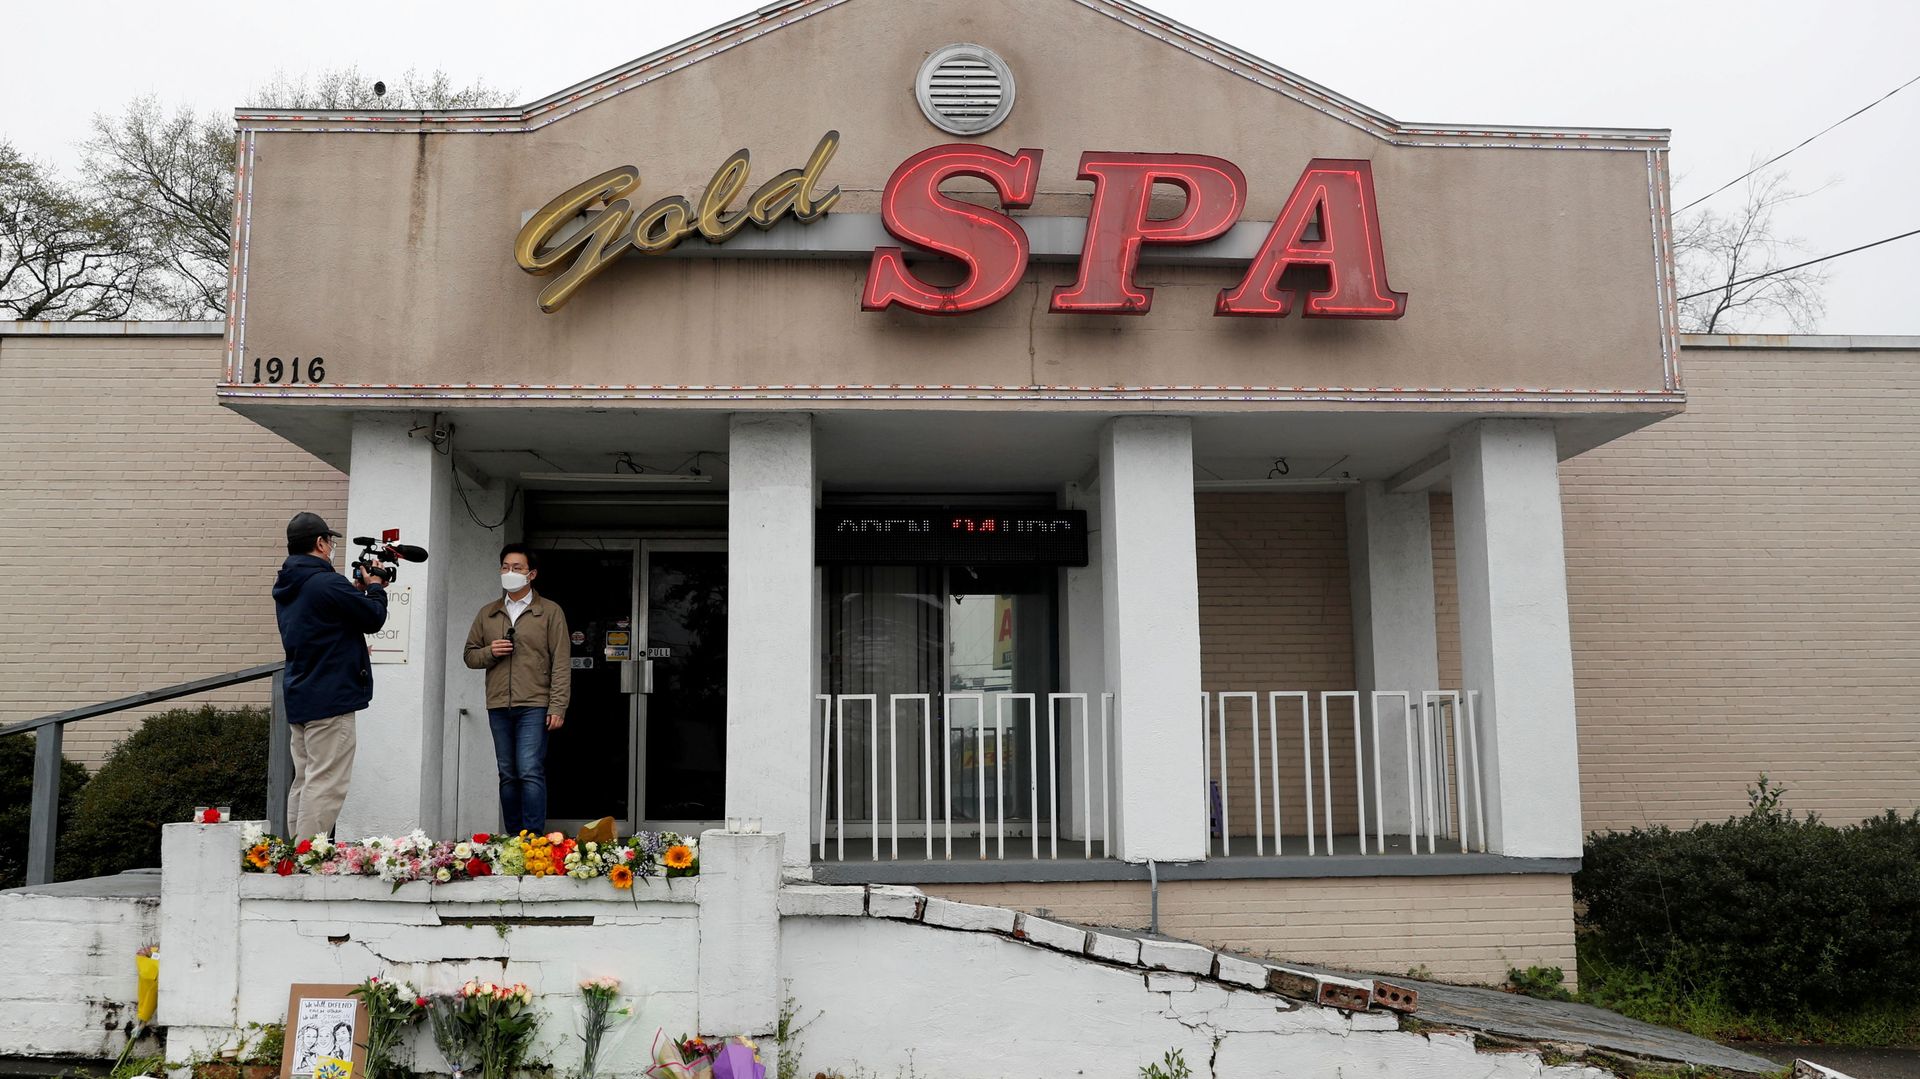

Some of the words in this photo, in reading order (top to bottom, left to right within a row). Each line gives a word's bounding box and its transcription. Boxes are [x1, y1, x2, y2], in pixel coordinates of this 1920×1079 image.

[514, 130, 841, 314] Gold
[860, 143, 1408, 319] SPA
[253, 357, 326, 384] 1916
[648, 648, 669, 657] PULL
